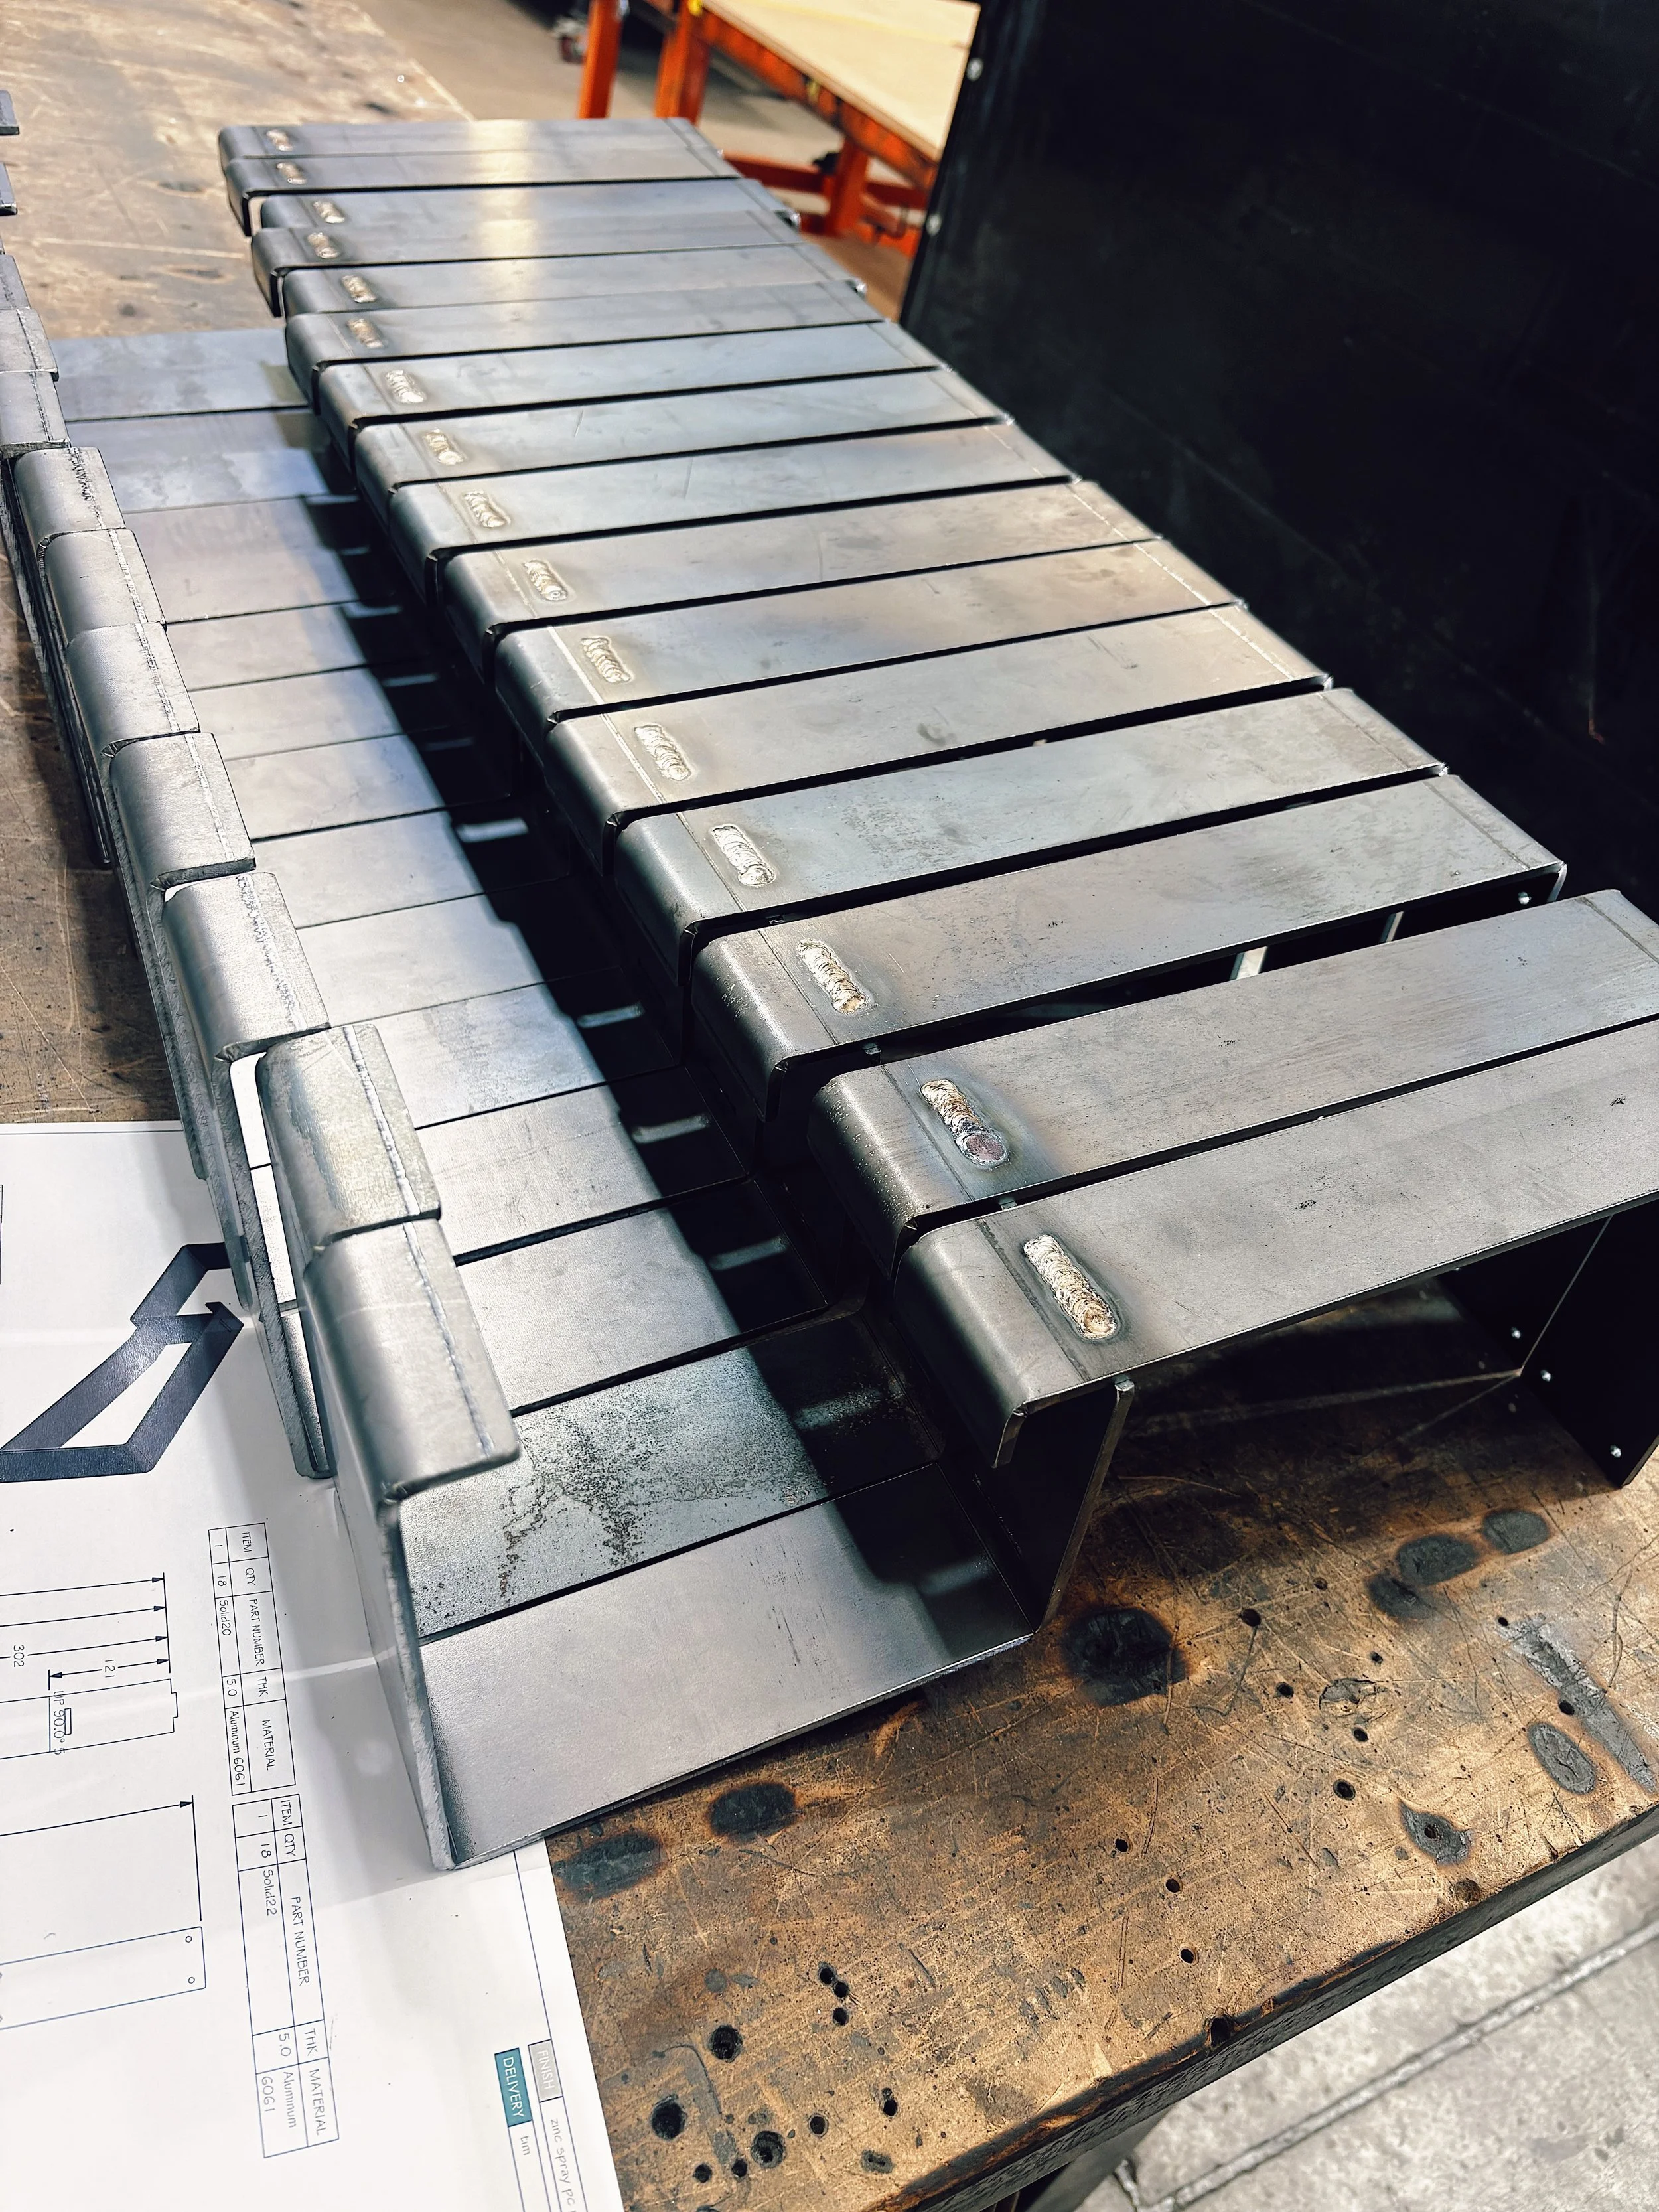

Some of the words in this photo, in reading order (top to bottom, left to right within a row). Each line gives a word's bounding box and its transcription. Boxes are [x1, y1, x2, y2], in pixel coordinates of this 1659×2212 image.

[242, 1532, 252, 1553] ITEM
[217, 1575, 227, 1587] 18
[245, 1568, 256, 1585] QTY
[219, 1599, 232, 1636] Solid20
[249, 1599, 261, 1621] PART
[13, 1645, 25, 1667] 302
[252, 1625, 265, 1666] NUMBER
[104, 1659, 115, 1678] 121
[53, 1690, 64, 1706] UP
[226, 1678, 238, 1696] 5.0
[257, 1676, 268, 1697] THK
[229, 1710, 240, 1754] Aluminum
[261, 1719, 275, 1771] MATERIAL
[234, 1757, 246, 1786] 6061
[281, 1799, 293, 1826] ITEM
[261, 1843, 272, 1858] 18
[284, 1833, 296, 1856] QTY
[263, 1869, 277, 1916] Solid22
[290, 1896, 304, 1926] PART
[294, 1931, 310, 1986] NUMBER
[279, 2033, 292, 2057] 5.0
[305, 2028, 318, 2056] THK
[537, 2049, 555, 2090] FINISH
[261, 2076, 275, 2112] 6061
[283, 2071, 297, 2128] Aluminum
[502, 2056, 525, 2117] DELIVERY
[309, 2069, 326, 2136] MATERIAL
[550, 2118, 563, 2143] zinc
[520, 2135, 530, 2156] tim
[554, 2147, 571, 2184] spray
